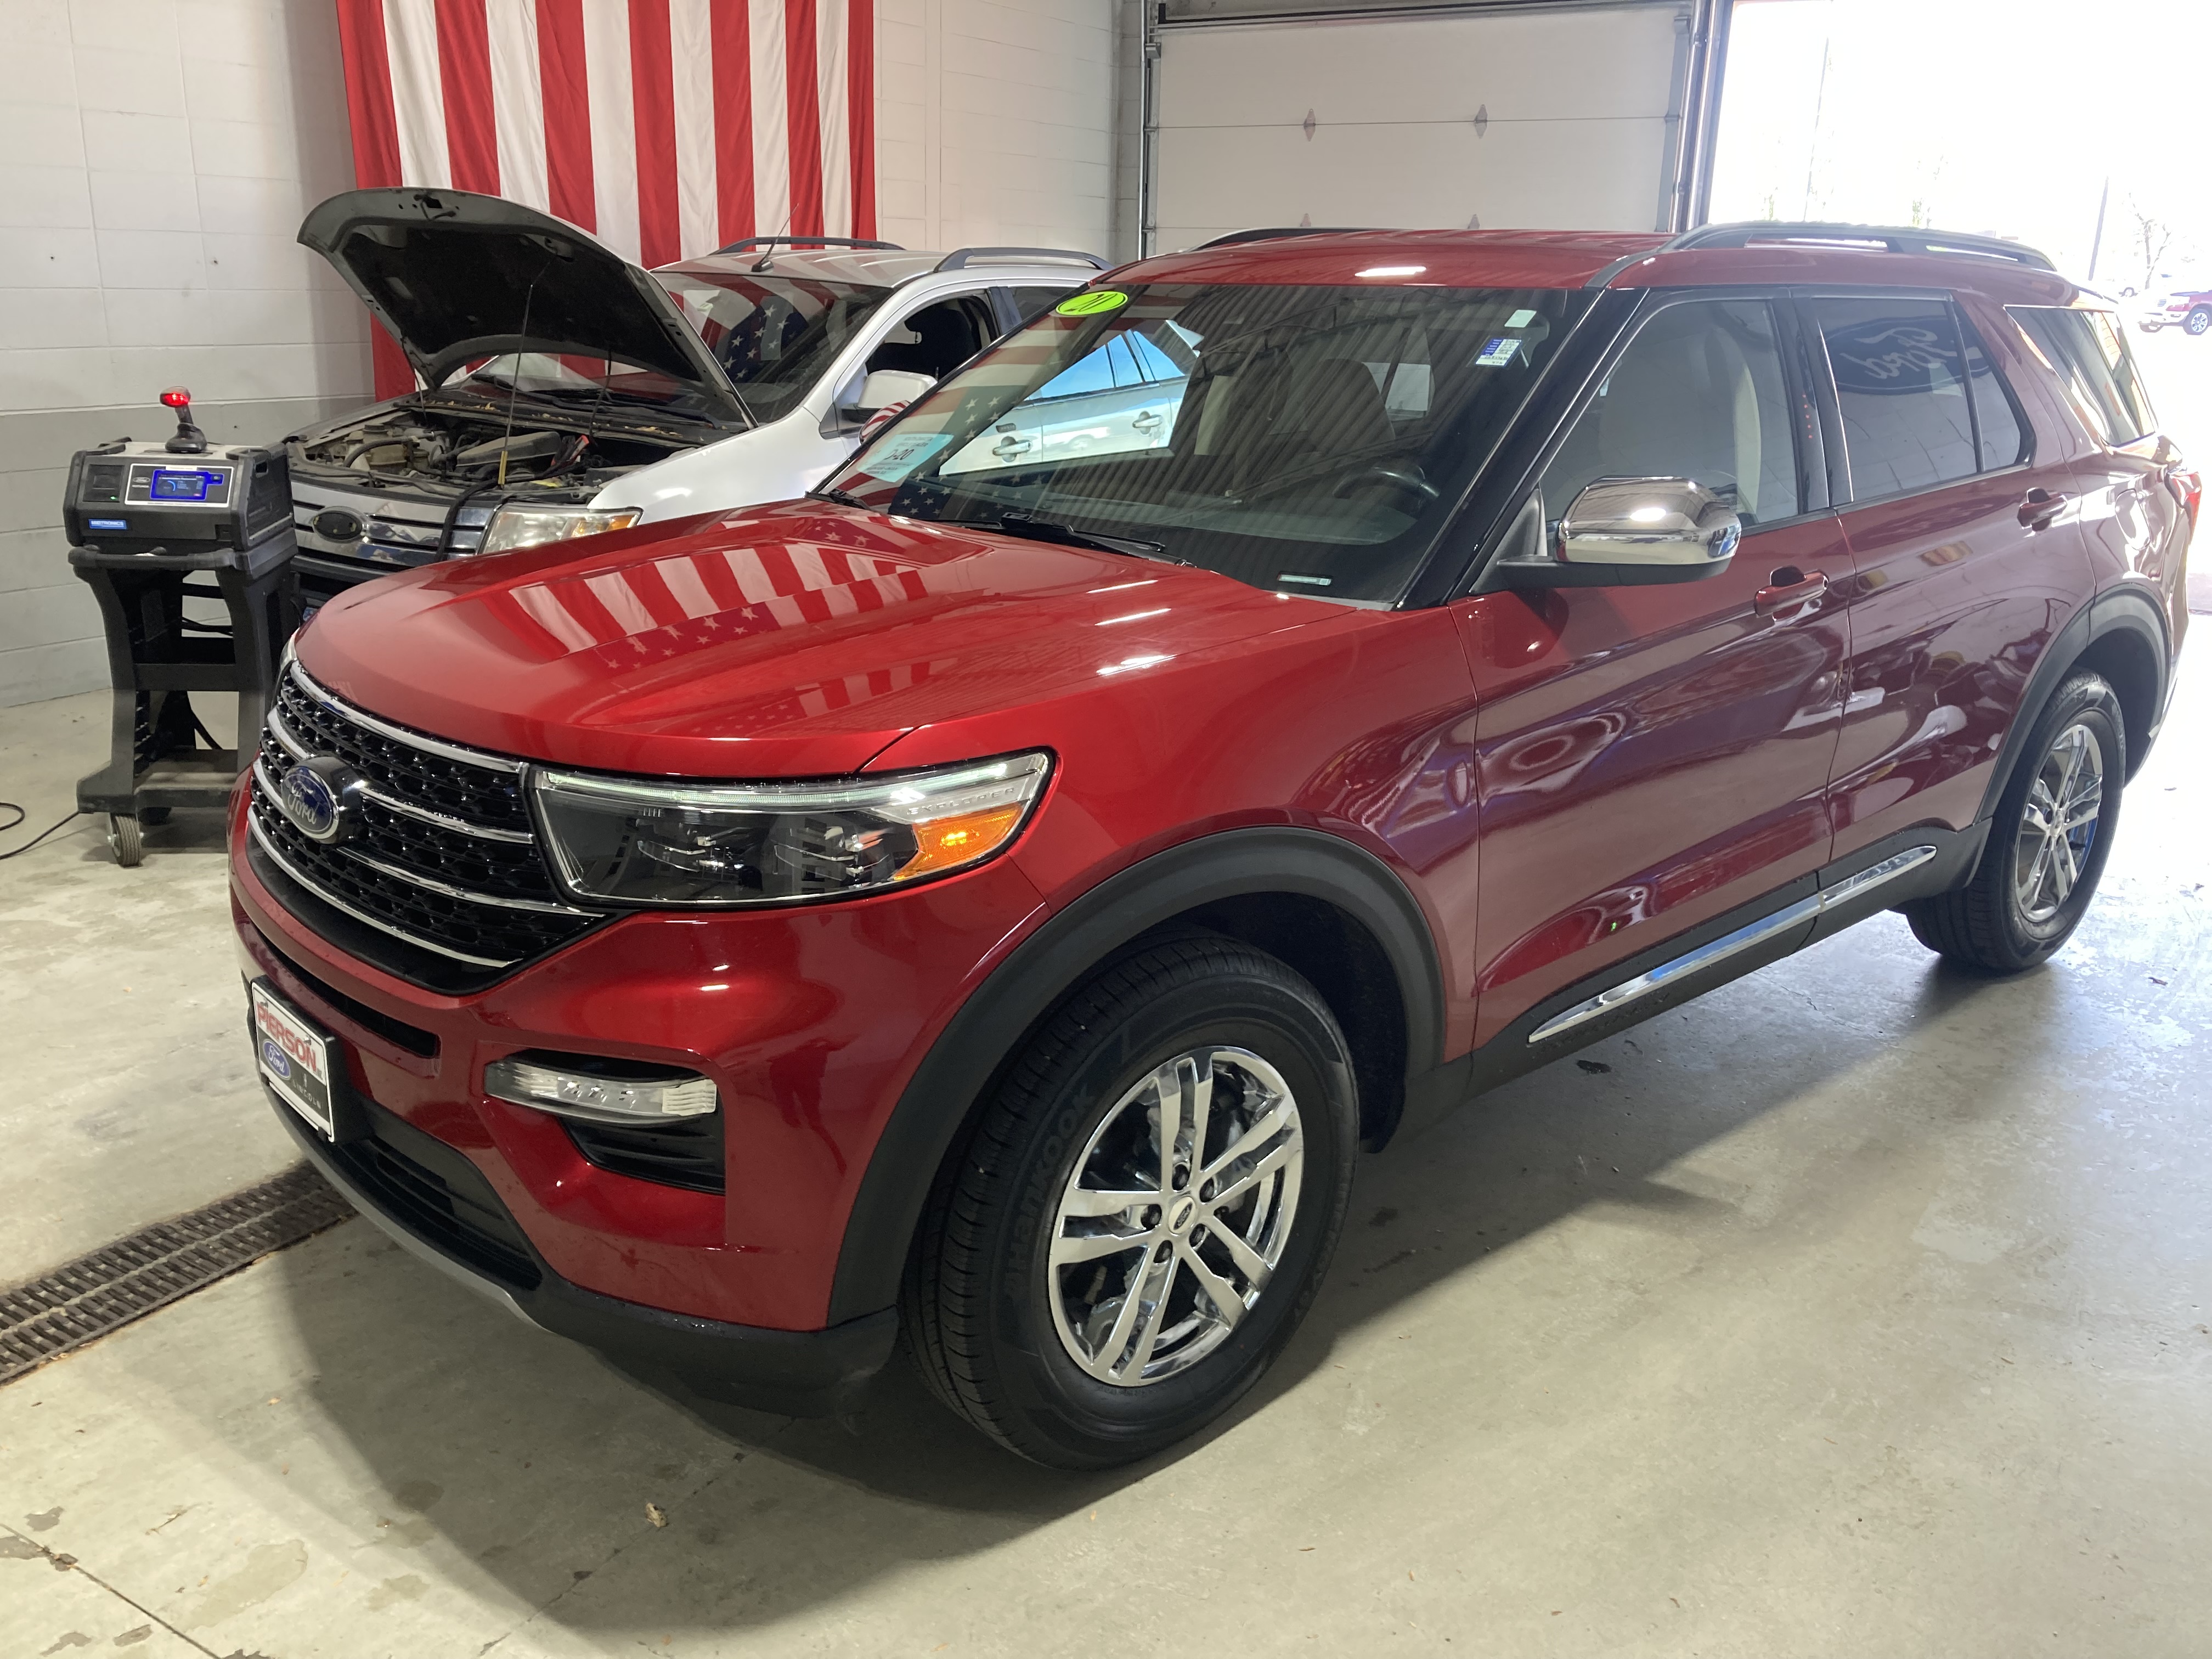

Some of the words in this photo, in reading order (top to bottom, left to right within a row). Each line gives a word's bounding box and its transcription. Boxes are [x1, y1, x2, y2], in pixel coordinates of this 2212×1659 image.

[287, 780, 320, 825] Ford
[906, 787, 1015, 816] EXPLORER
[256, 1002, 317, 1072] PIERSON
[268, 1045, 286, 1074] Ford
[292, 1080, 322, 1109] LINCOLN
